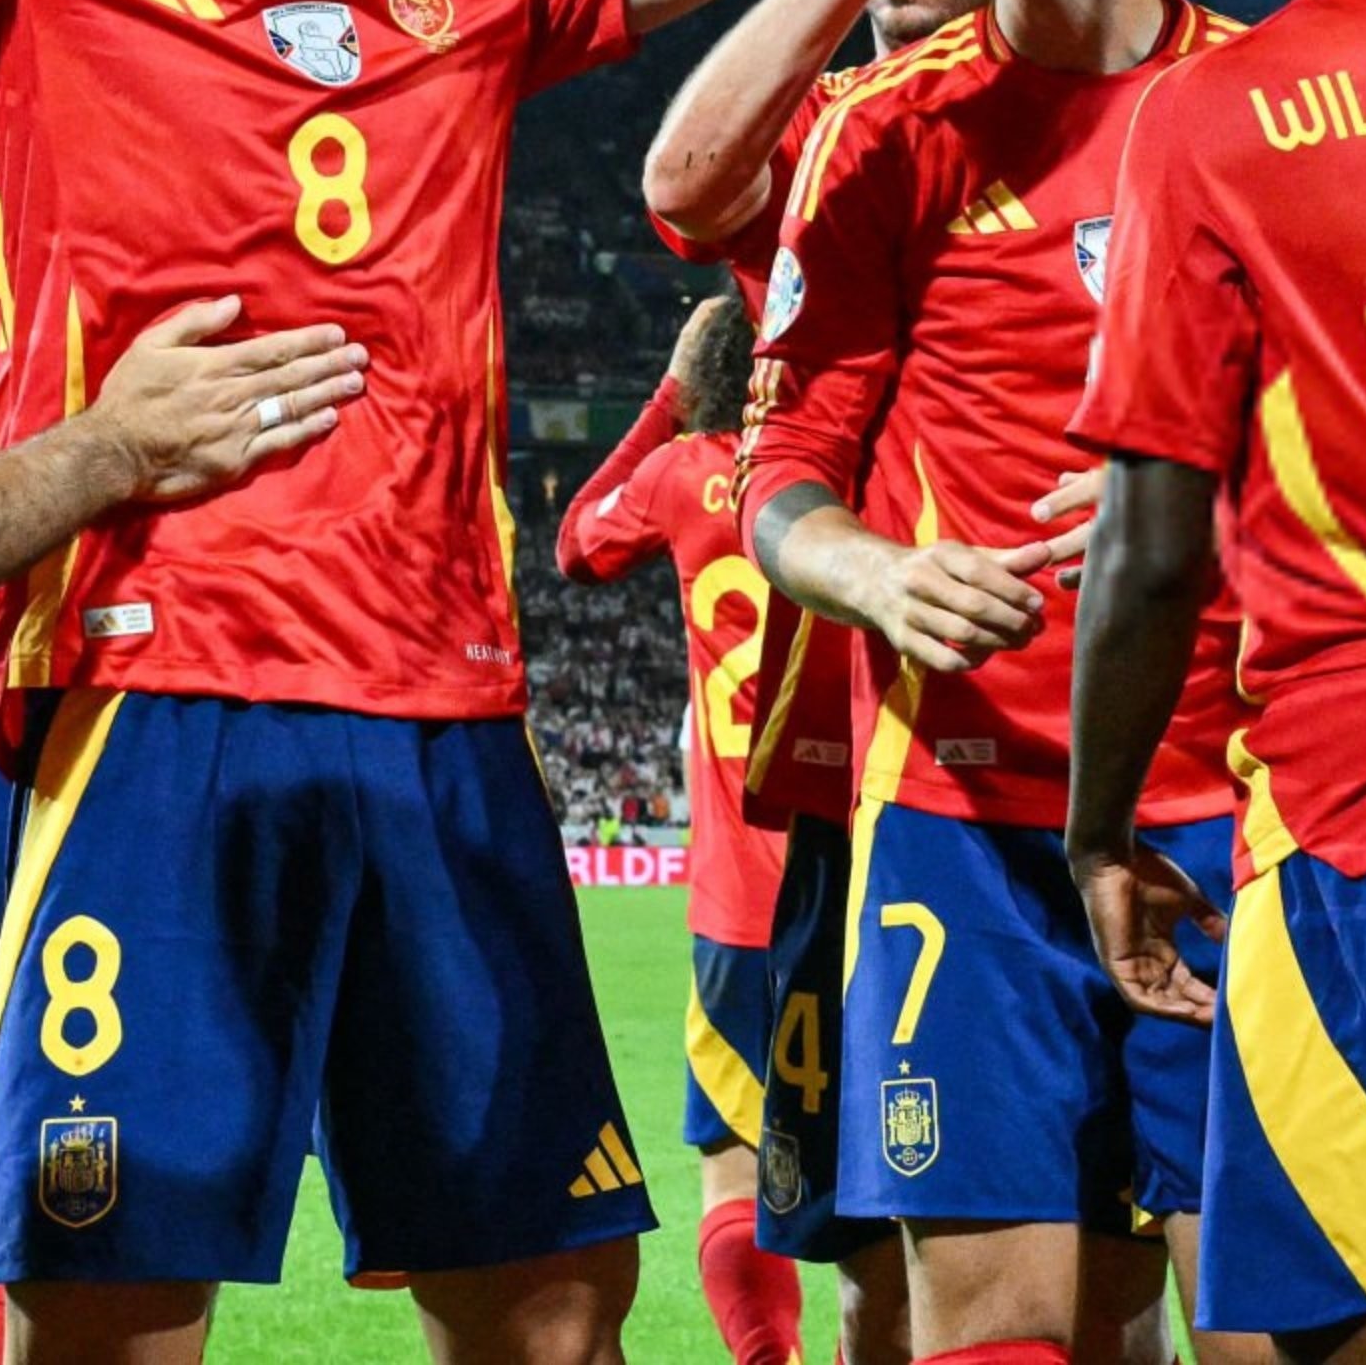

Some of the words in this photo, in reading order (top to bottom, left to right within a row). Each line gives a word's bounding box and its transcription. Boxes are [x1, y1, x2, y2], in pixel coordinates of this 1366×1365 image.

[288, 113, 372, 266] 8
[691, 554, 771, 758] 2
[40, 914, 123, 1077] 8
[880, 902, 947, 1045] 7
[774, 992, 828, 1113] 4
